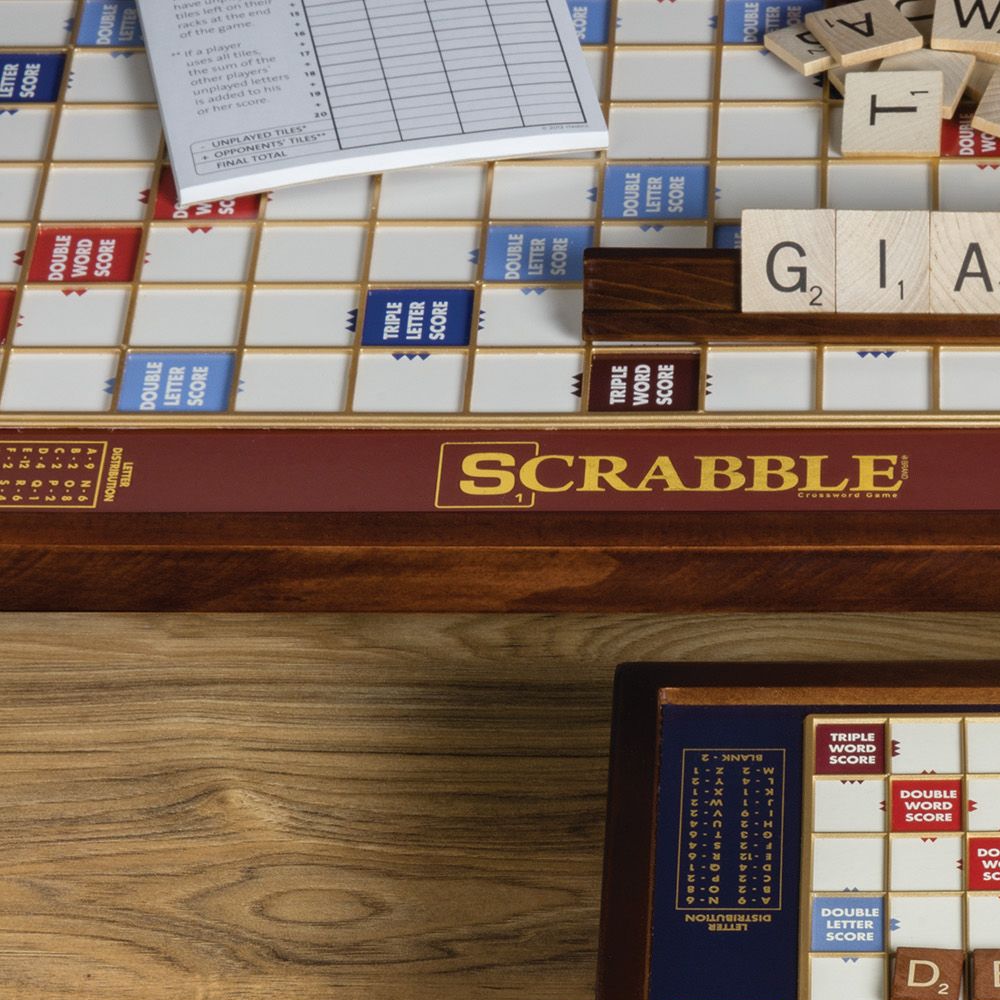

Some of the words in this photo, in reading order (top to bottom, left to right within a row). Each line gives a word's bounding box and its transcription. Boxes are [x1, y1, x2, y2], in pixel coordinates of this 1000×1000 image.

[20, 63, 41, 98] SCORE
[216, 158, 249, 169] FINAL
[252, 151, 288, 162] TOTAL
[622, 171, 641, 217] DOUBLE
[645, 175, 663, 212] LETTER
[667, 175, 685, 212] SCORE
[47, 234, 72, 278] DOUBLE
[70, 238, 93, 278] WORD
[93, 238, 116, 277] SCORE
[503, 232, 525, 279] DOUBLE
[526, 236, 547, 276] LETTER
[550, 236, 569, 275] SCORE
[382, 301, 402, 340] TRIPLE
[405, 301, 425, 340] LETTER
[428, 300, 448, 340] SCORE
[138, 361, 163, 410] DOUBLE
[162, 365, 186, 406] LETTER
[185, 365, 209, 406] SCORE
[609, 365, 627, 405] TRIPLE
[632, 363, 651, 406] WORD
[655, 364, 674, 405] SCORE
[104, 447, 124, 502] DISTRIBUTION
[120, 462, 134, 487] LETTER
[458, 451, 904, 495] SCRABBLE
[828, 743, 876, 753] WORD
[829, 732, 875, 741] TRIPLE
[722, 754, 763, 762] BLANK
[828, 754, 875, 764] SCORE
[685, 914, 772, 922] DISTRIBUTION
[820, 907, 879, 917] DOUBLE
[825, 919, 874, 929] LETTER
[825, 931, 874, 941] SCORE
